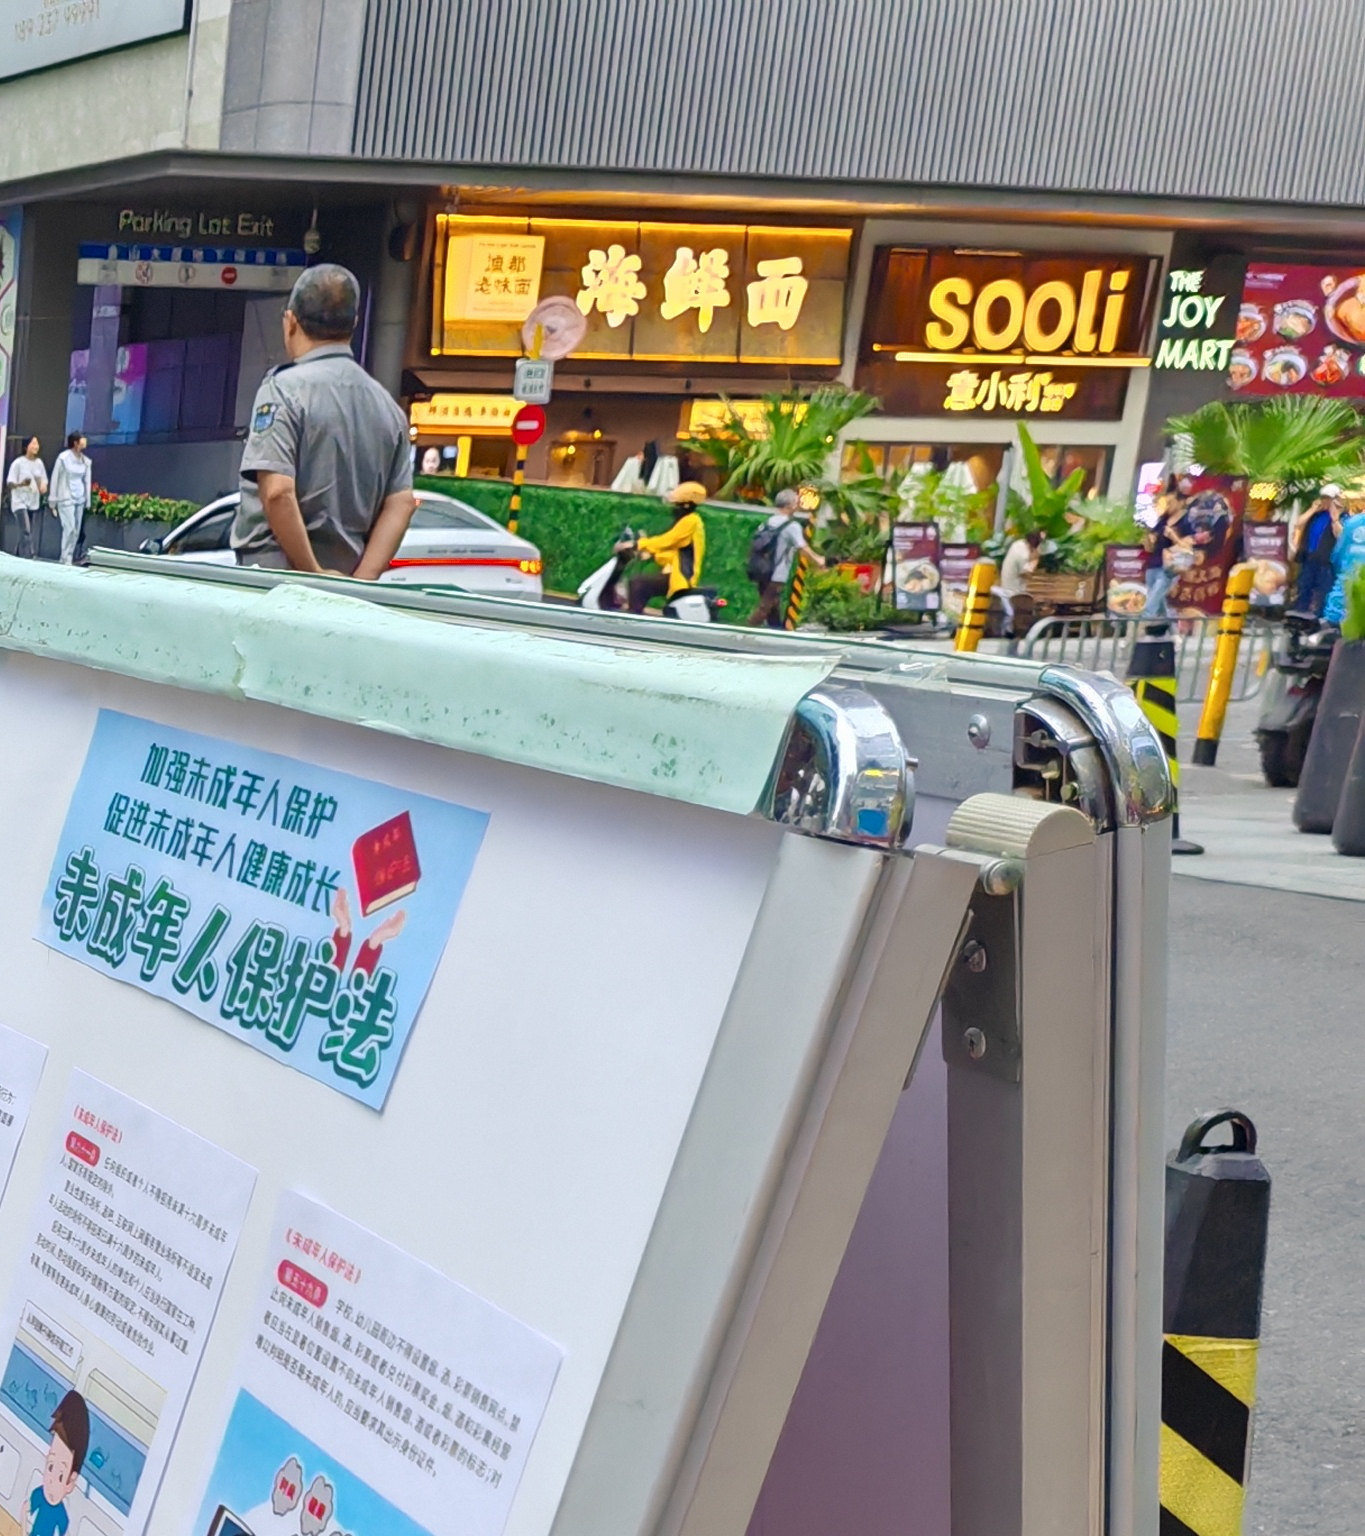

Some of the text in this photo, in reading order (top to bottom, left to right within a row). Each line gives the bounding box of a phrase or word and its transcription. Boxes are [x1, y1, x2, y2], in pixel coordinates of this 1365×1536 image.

[119, 209, 274, 239] Parking Lot Exit
[1169, 269, 1206, 293] THE
[1162, 295, 1226, 329] JOY
[1155, 337, 1236, 372] MART
[140, 742, 338, 840] 加强未成年人保护
[103, 792, 342, 918] 促进未成年人健康成长
[53, 845, 399, 1090] 未成年人保护法
